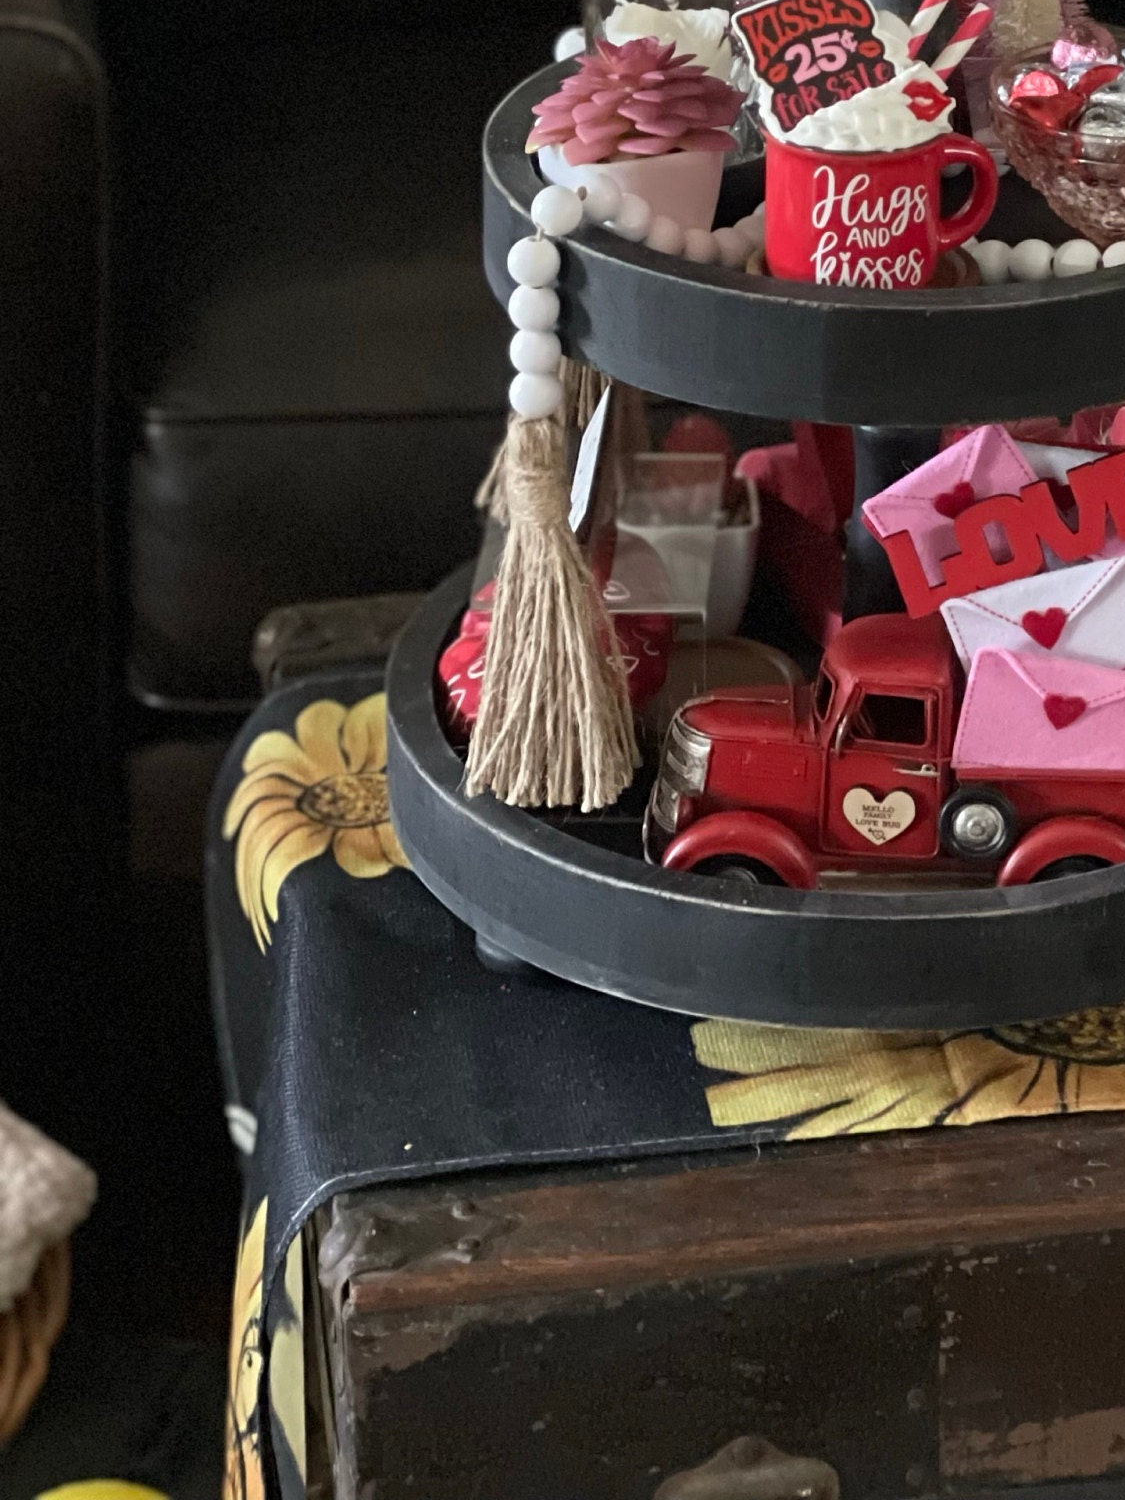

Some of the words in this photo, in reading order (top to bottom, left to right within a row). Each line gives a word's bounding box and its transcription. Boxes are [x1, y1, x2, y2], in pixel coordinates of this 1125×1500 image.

[785, 29, 858, 85] 25¢
[811, 165, 928, 236] Hugs
[846, 227, 890, 249] AND
[810, 231, 925, 290] kisses
[855, 819, 879, 827] LOVE
[882, 820, 901, 829] BUG
[863, 811, 892, 819] FAMILY
